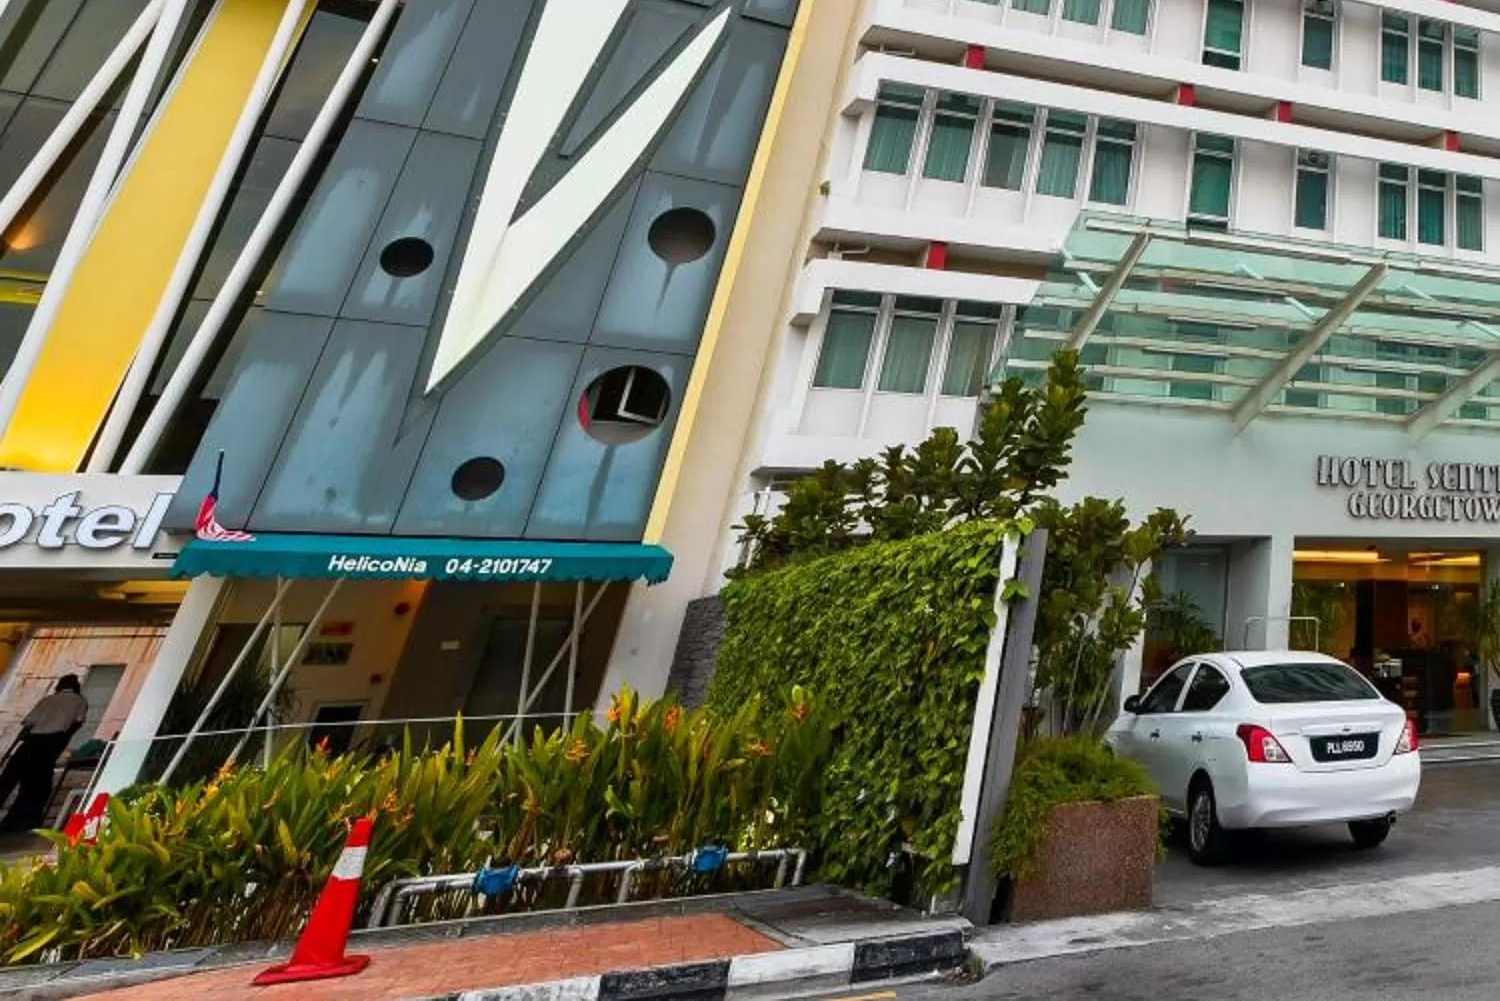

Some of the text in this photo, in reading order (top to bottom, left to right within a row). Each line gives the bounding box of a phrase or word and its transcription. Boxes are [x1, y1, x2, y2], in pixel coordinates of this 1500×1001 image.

[1317, 455, 1416, 490] HOTEL
[328, 555, 552, 574] HelicoNia 04-2101747
